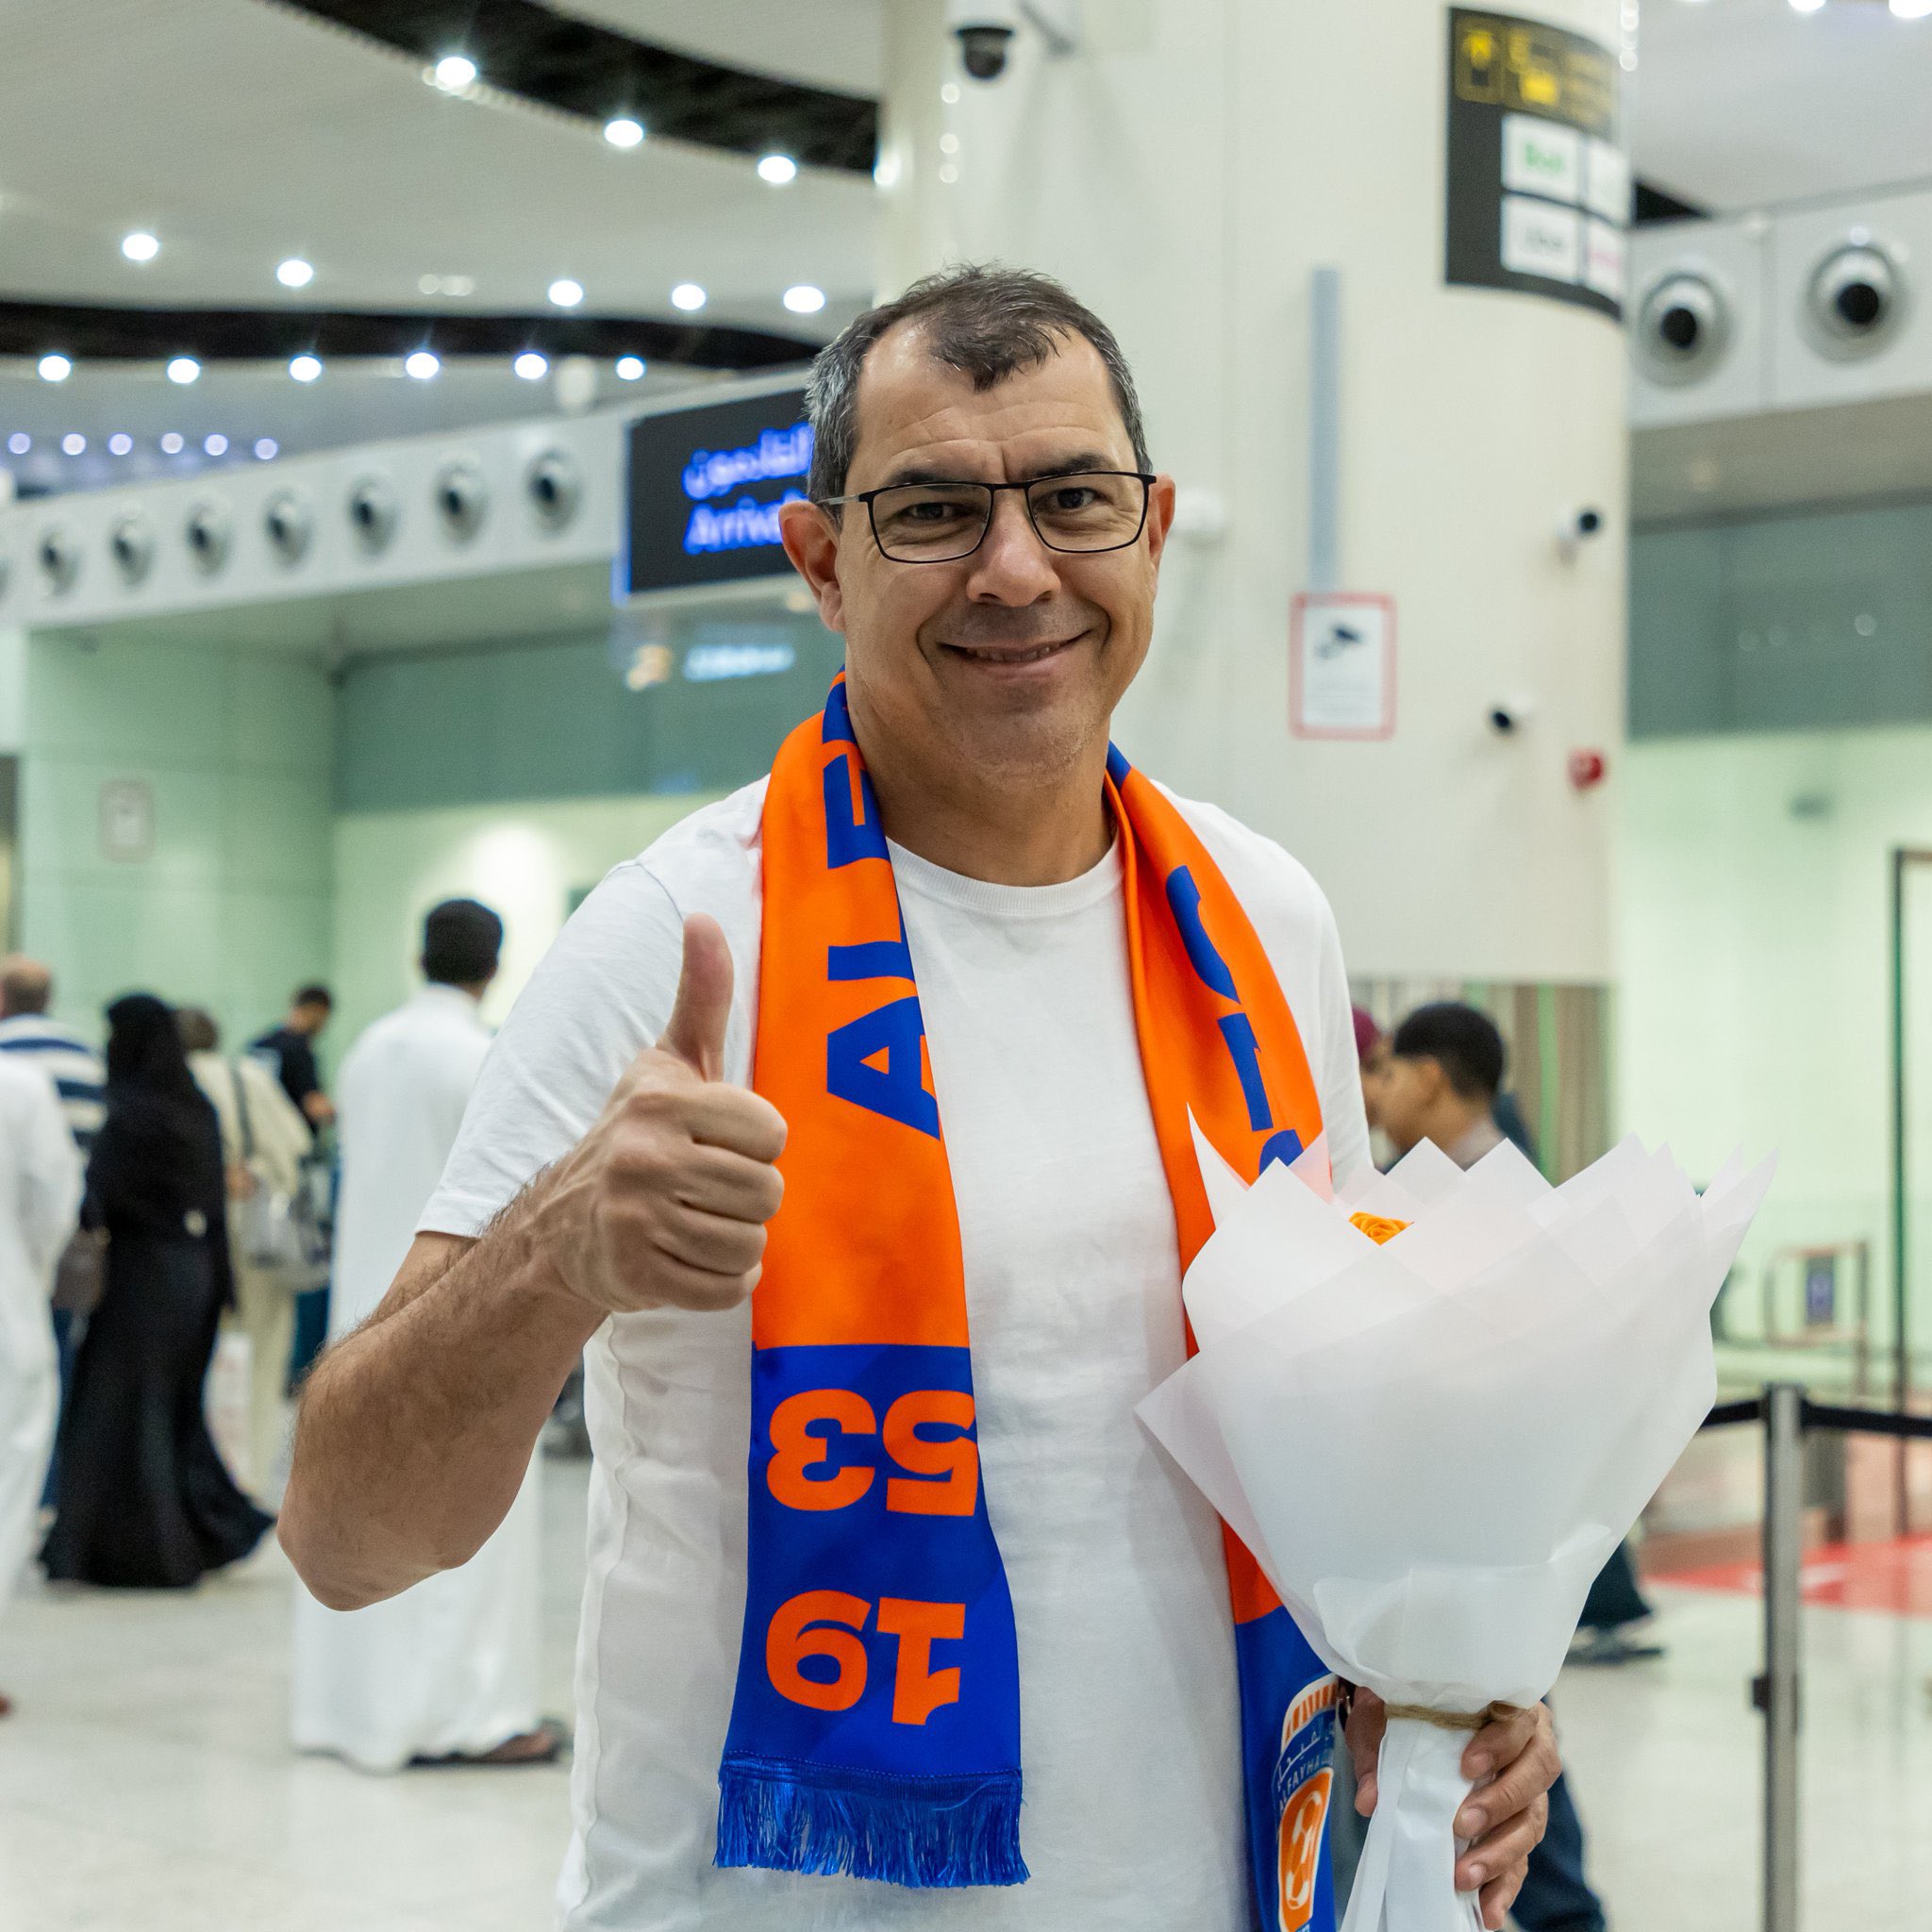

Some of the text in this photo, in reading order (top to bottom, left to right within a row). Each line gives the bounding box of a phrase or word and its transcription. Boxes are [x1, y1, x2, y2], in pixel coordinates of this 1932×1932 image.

[684, 489, 807, 555] Arriva
[766, 1388, 979, 1517] 53
[765, 1589, 967, 1726] 19
